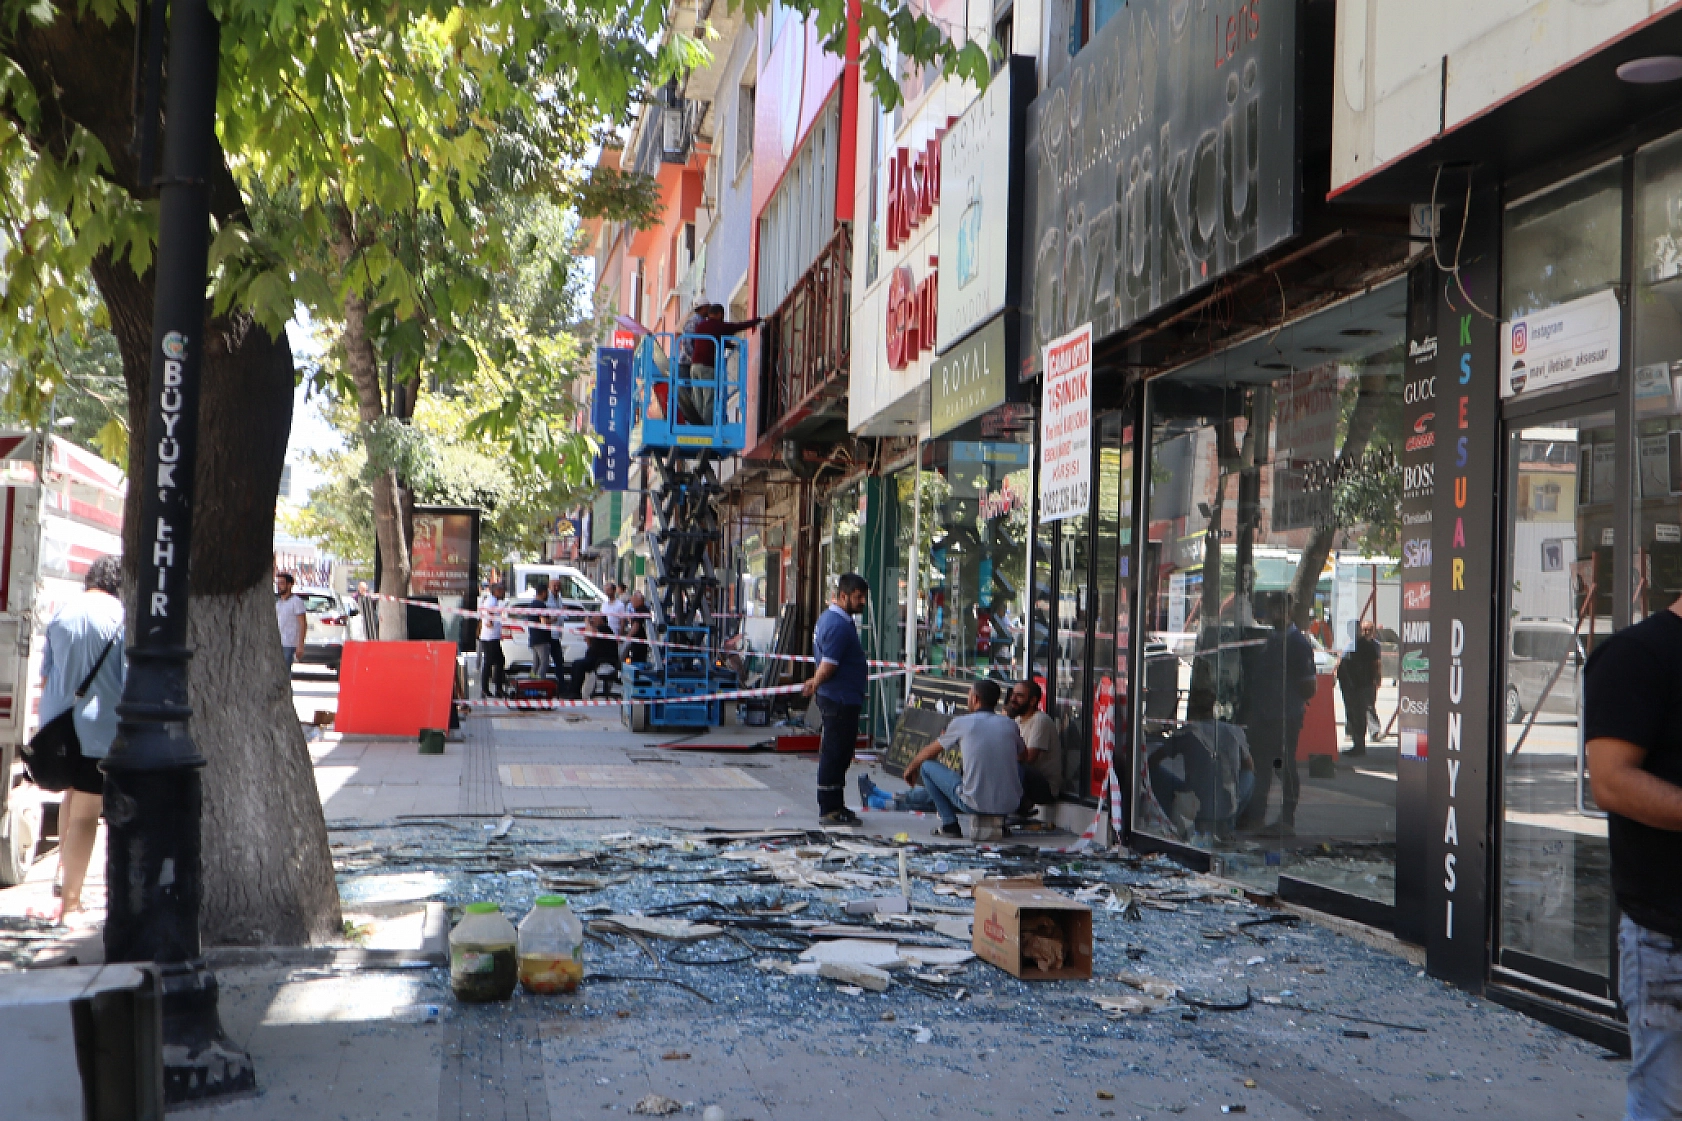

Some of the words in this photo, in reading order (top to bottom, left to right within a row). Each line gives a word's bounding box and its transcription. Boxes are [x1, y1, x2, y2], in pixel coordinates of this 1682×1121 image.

[1214, 0, 1260, 69] Lens
[607, 358, 619, 432] YILDIZ
[942, 340, 990, 398] ROYAL
[150, 360, 183, 617] BÜYÜKEHİR
[606, 446, 617, 482] PUB
[1444, 618, 1465, 940] DÜNYASI
